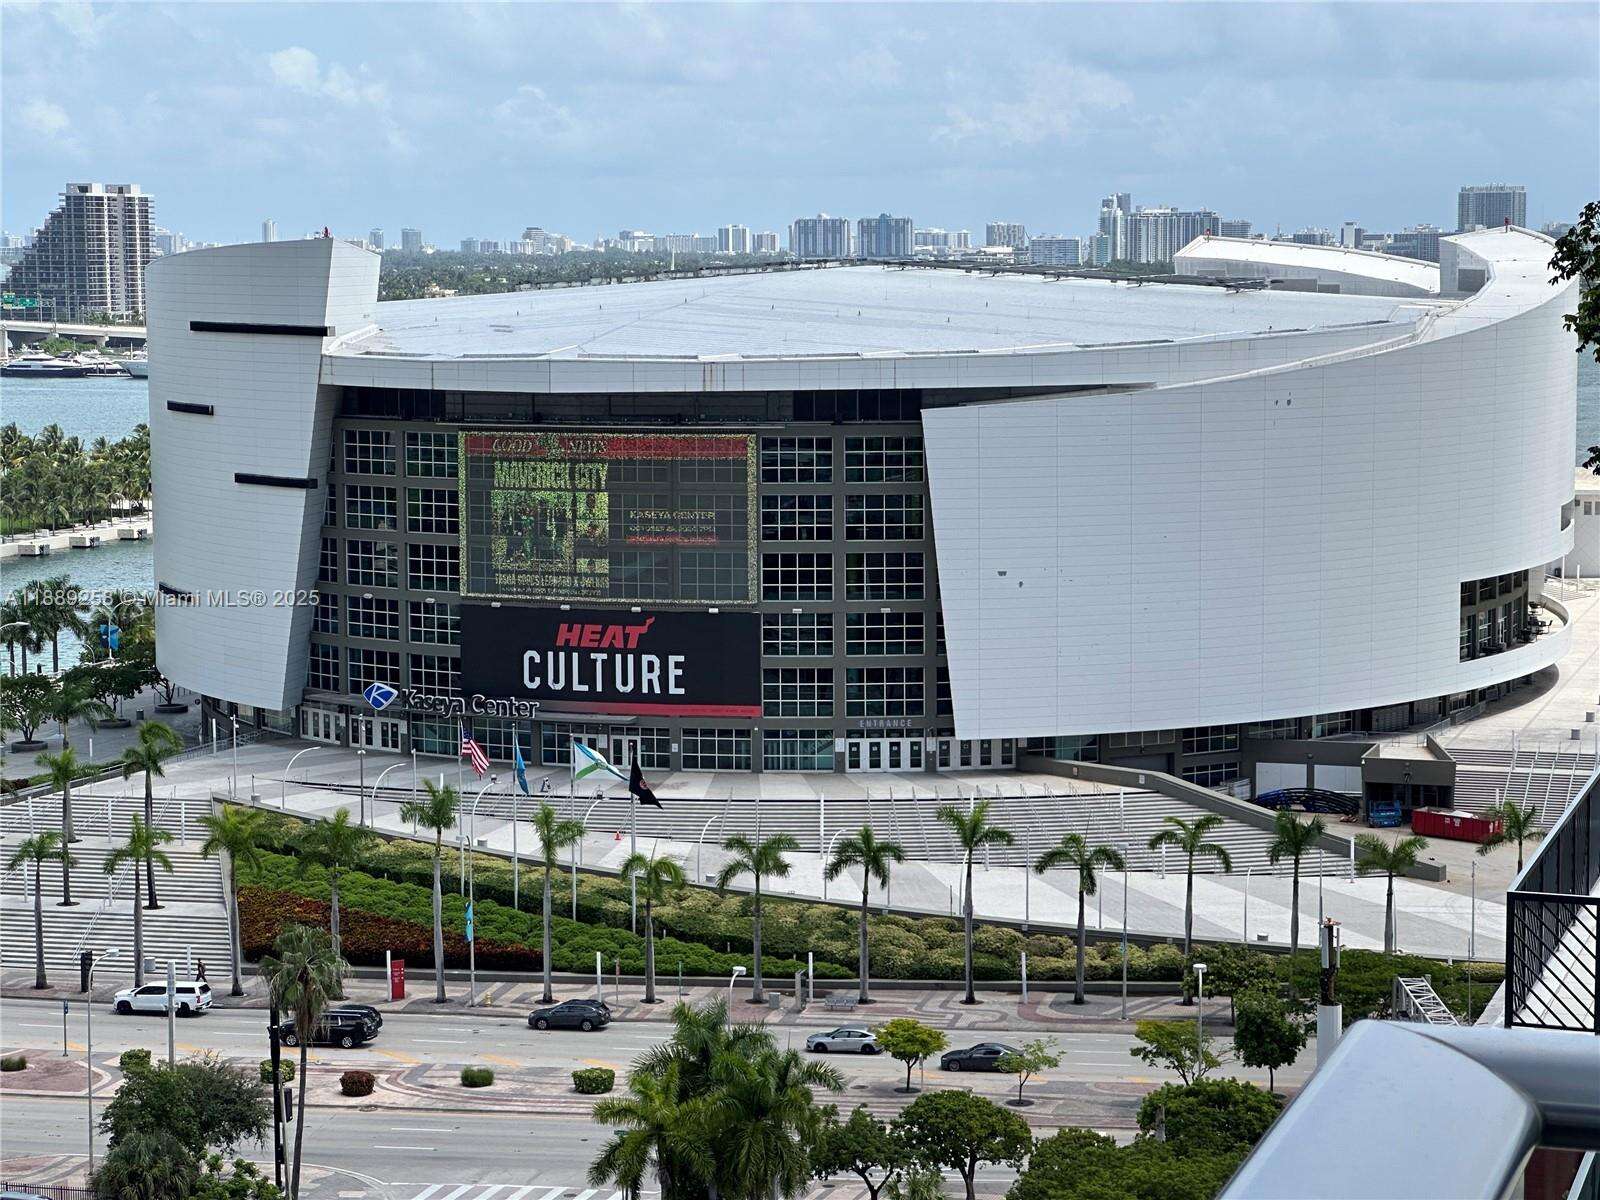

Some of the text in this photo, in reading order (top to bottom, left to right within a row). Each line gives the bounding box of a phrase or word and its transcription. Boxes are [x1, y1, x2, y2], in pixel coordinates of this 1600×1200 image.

[629, 510, 715, 519] KASEYA CENTER
[555, 616, 656, 649] HEAT
[523, 649, 686, 695] CULTURE
[401, 688, 540, 719] Kaseya Center
[859, 719, 912, 728] ENTRANCE
